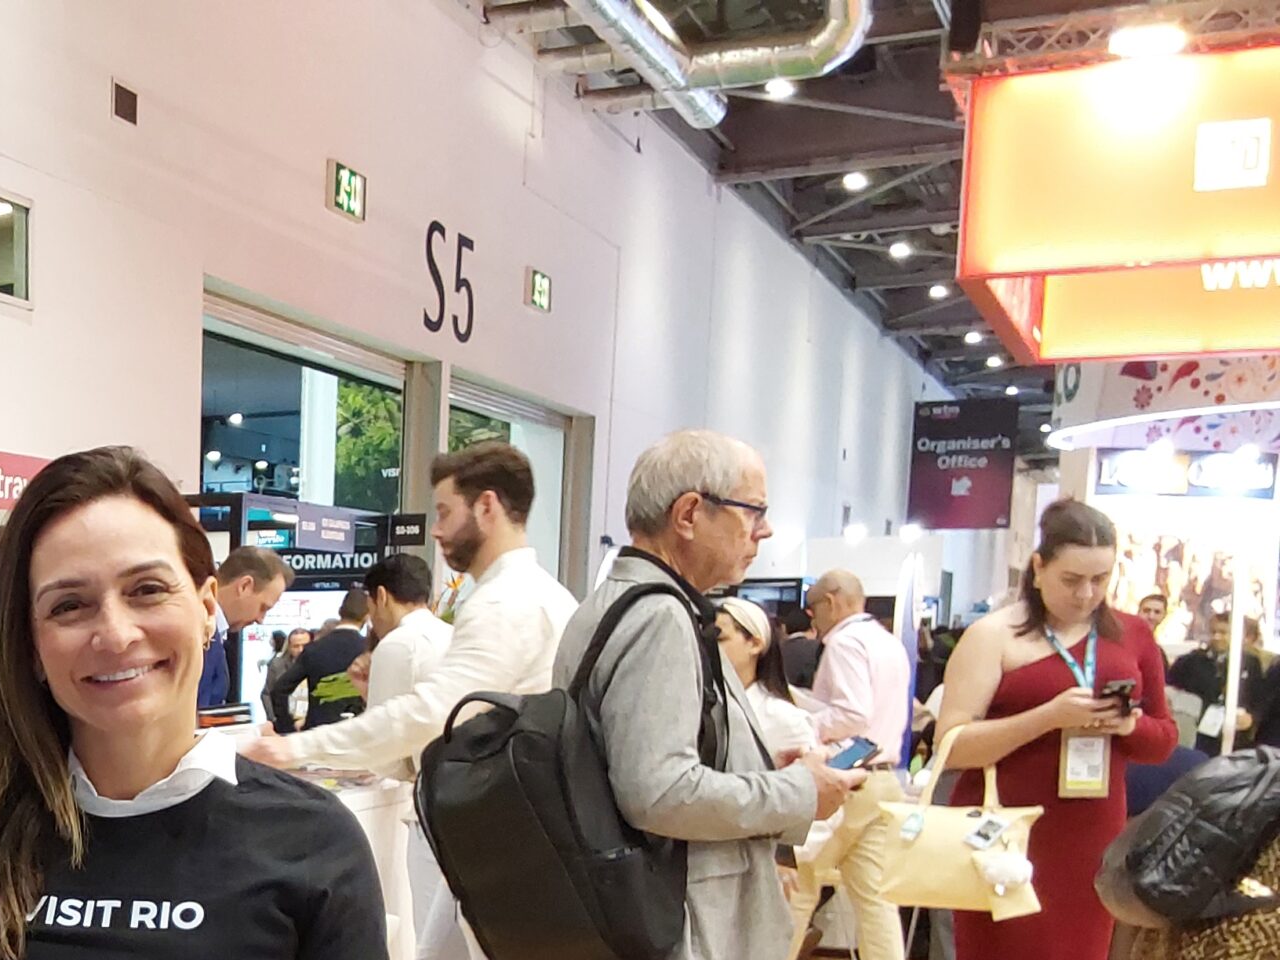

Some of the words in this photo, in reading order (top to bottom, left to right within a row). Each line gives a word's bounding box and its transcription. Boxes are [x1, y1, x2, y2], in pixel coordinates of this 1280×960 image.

[423, 220, 474, 343] S5
[1201, 258, 1280, 291] ww
[917, 433, 1011, 453] Organiser's
[937, 455, 988, 469] Office
[282, 552, 378, 570] FORMATIO
[130, 900, 205, 930] RIO
